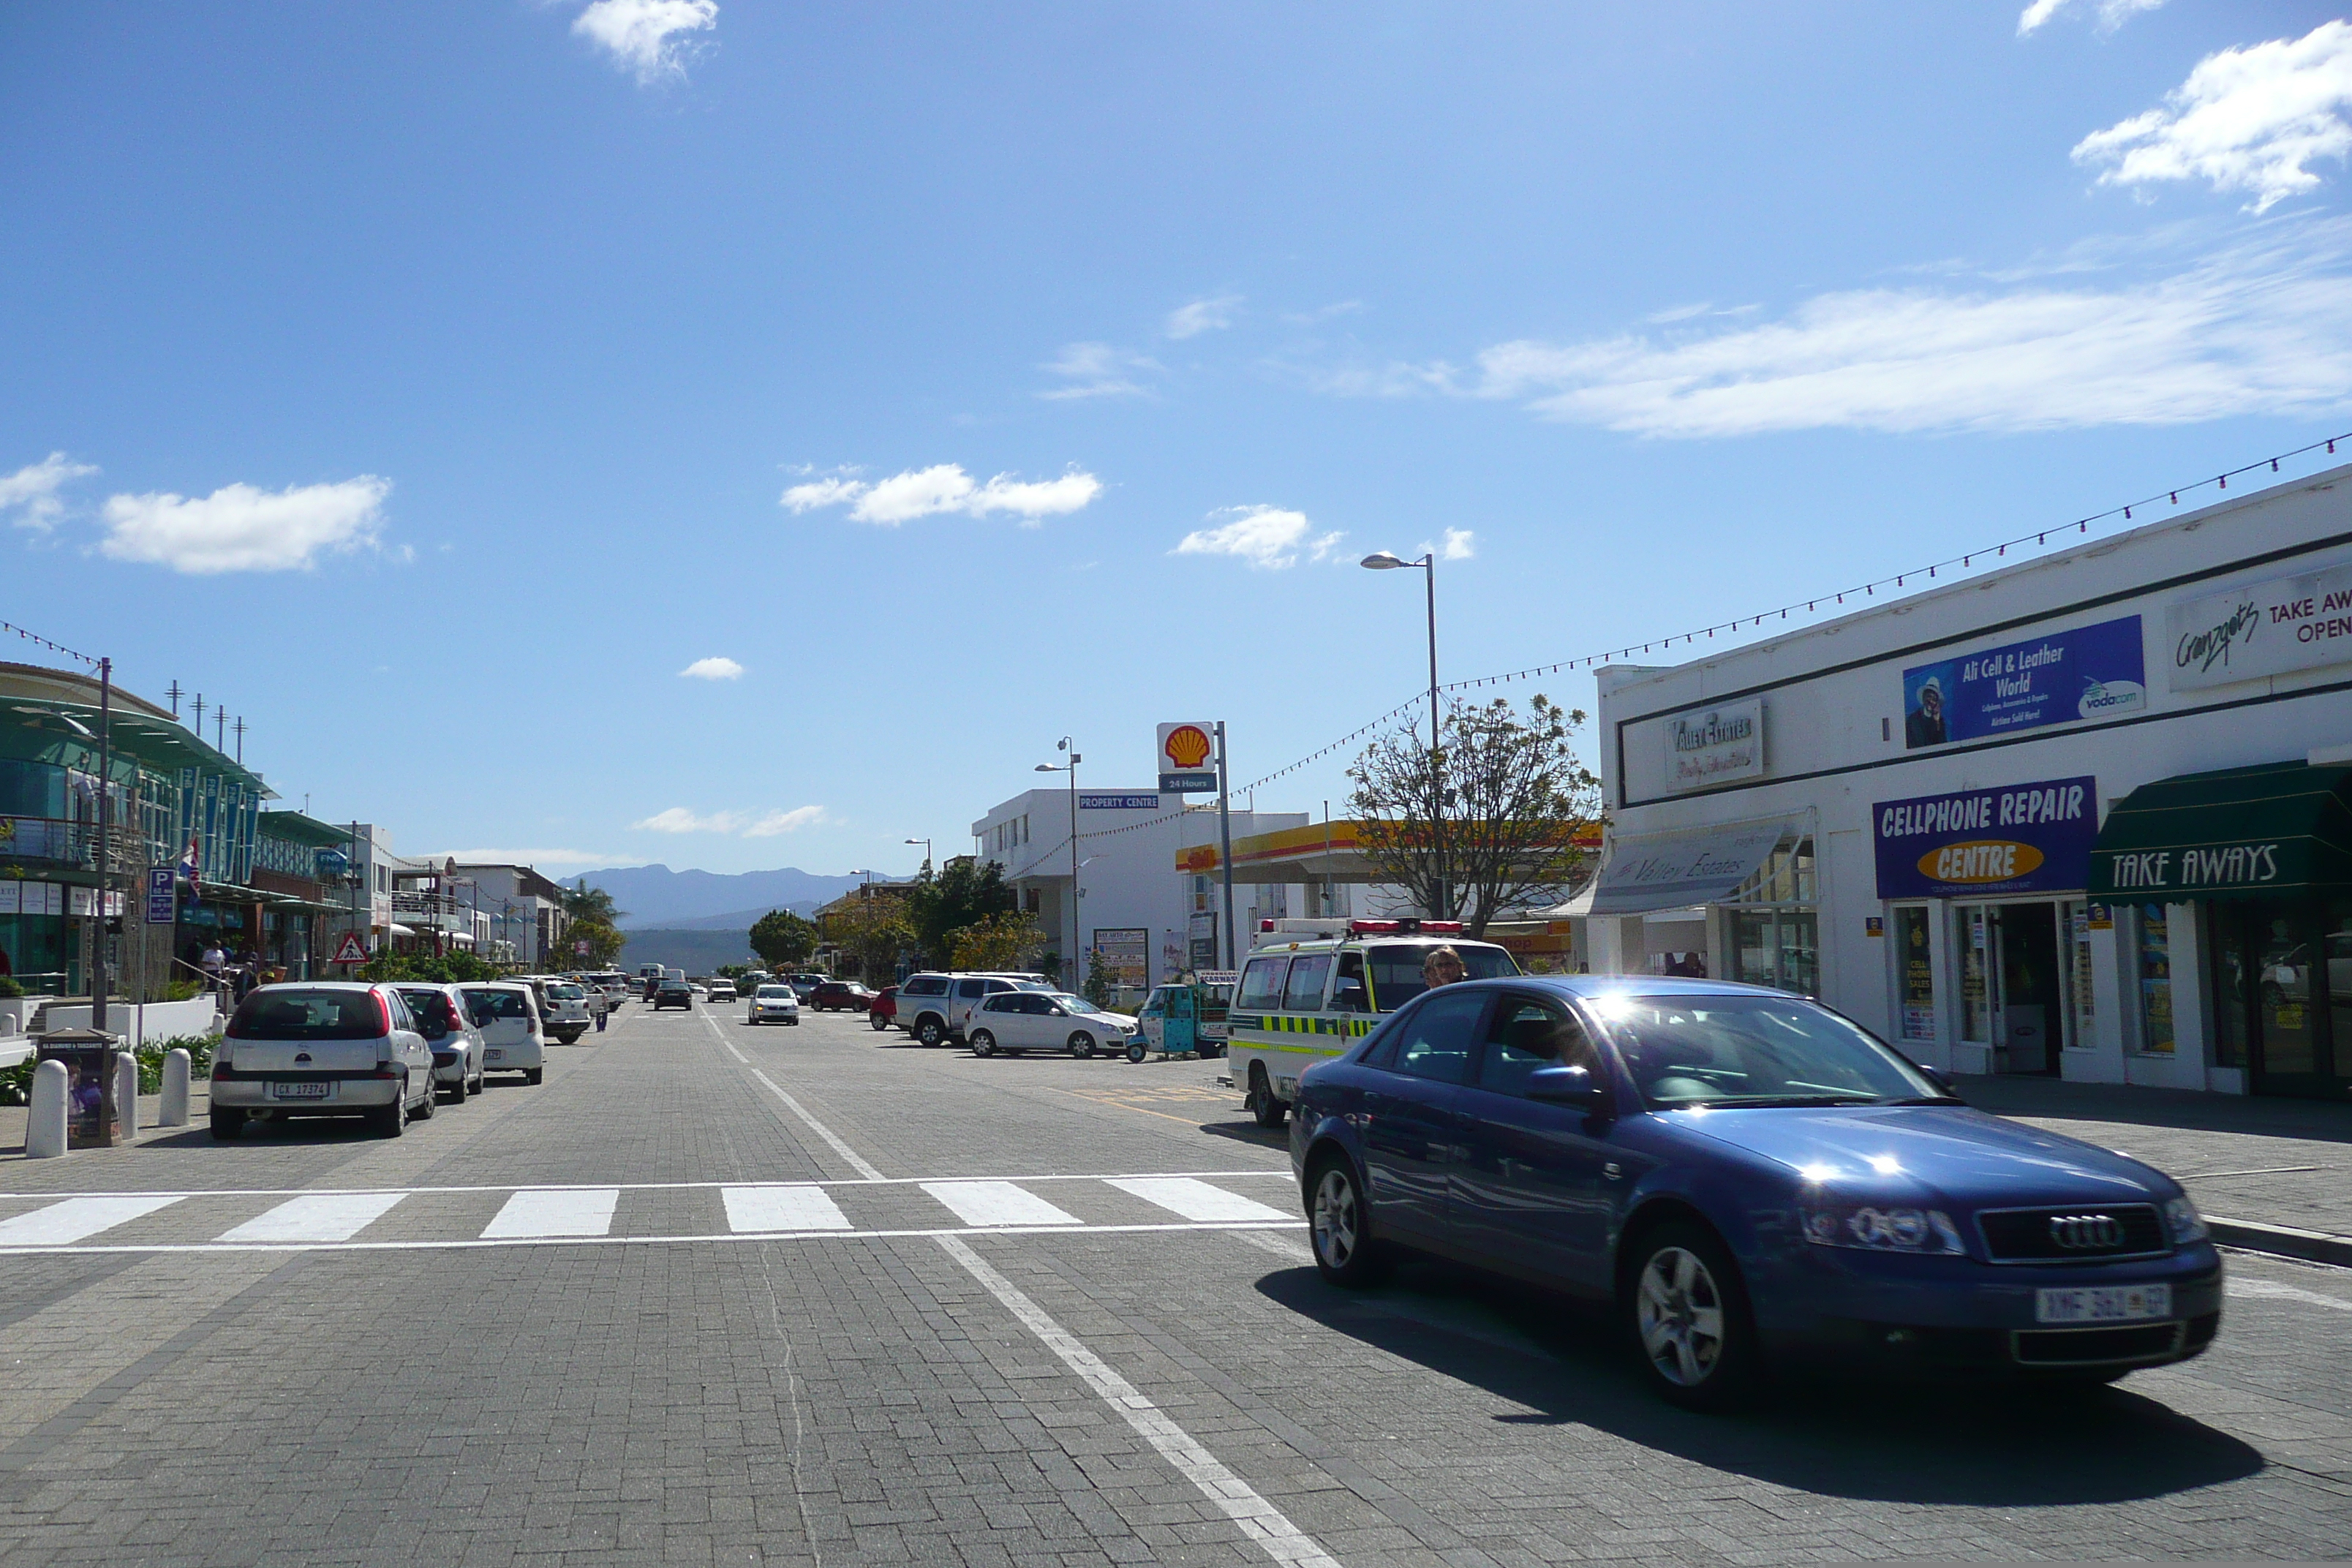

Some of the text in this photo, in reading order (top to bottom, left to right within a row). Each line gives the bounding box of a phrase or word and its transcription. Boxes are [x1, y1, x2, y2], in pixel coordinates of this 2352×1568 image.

[2269, 598, 2313, 623] TAKE
[2297, 616, 2352, 642] OPEN
[1962, 644, 2064, 682] Ali Cell & Leather
[1997, 672, 2031, 698] World
[2087, 691, 2137, 709] vodacom
[1182, 780, 1207, 788] Hours
[1080, 797, 1158, 807] PROPERTY CENTRE
[1882, 785, 2084, 838] CELLPHONE REPAIR
[1686, 853, 1745, 877] Estates
[1937, 845, 2017, 879] CENTRE
[2113, 845, 2278, 887] TAKE AWAYS
[156, 872, 168, 886] P
[1907, 970, 1931, 979] PHONE
[1910, 960, 1926, 968] CELL
[1910, 980, 1930, 988] SALES
[279, 1084, 324, 1094] CX 17374
